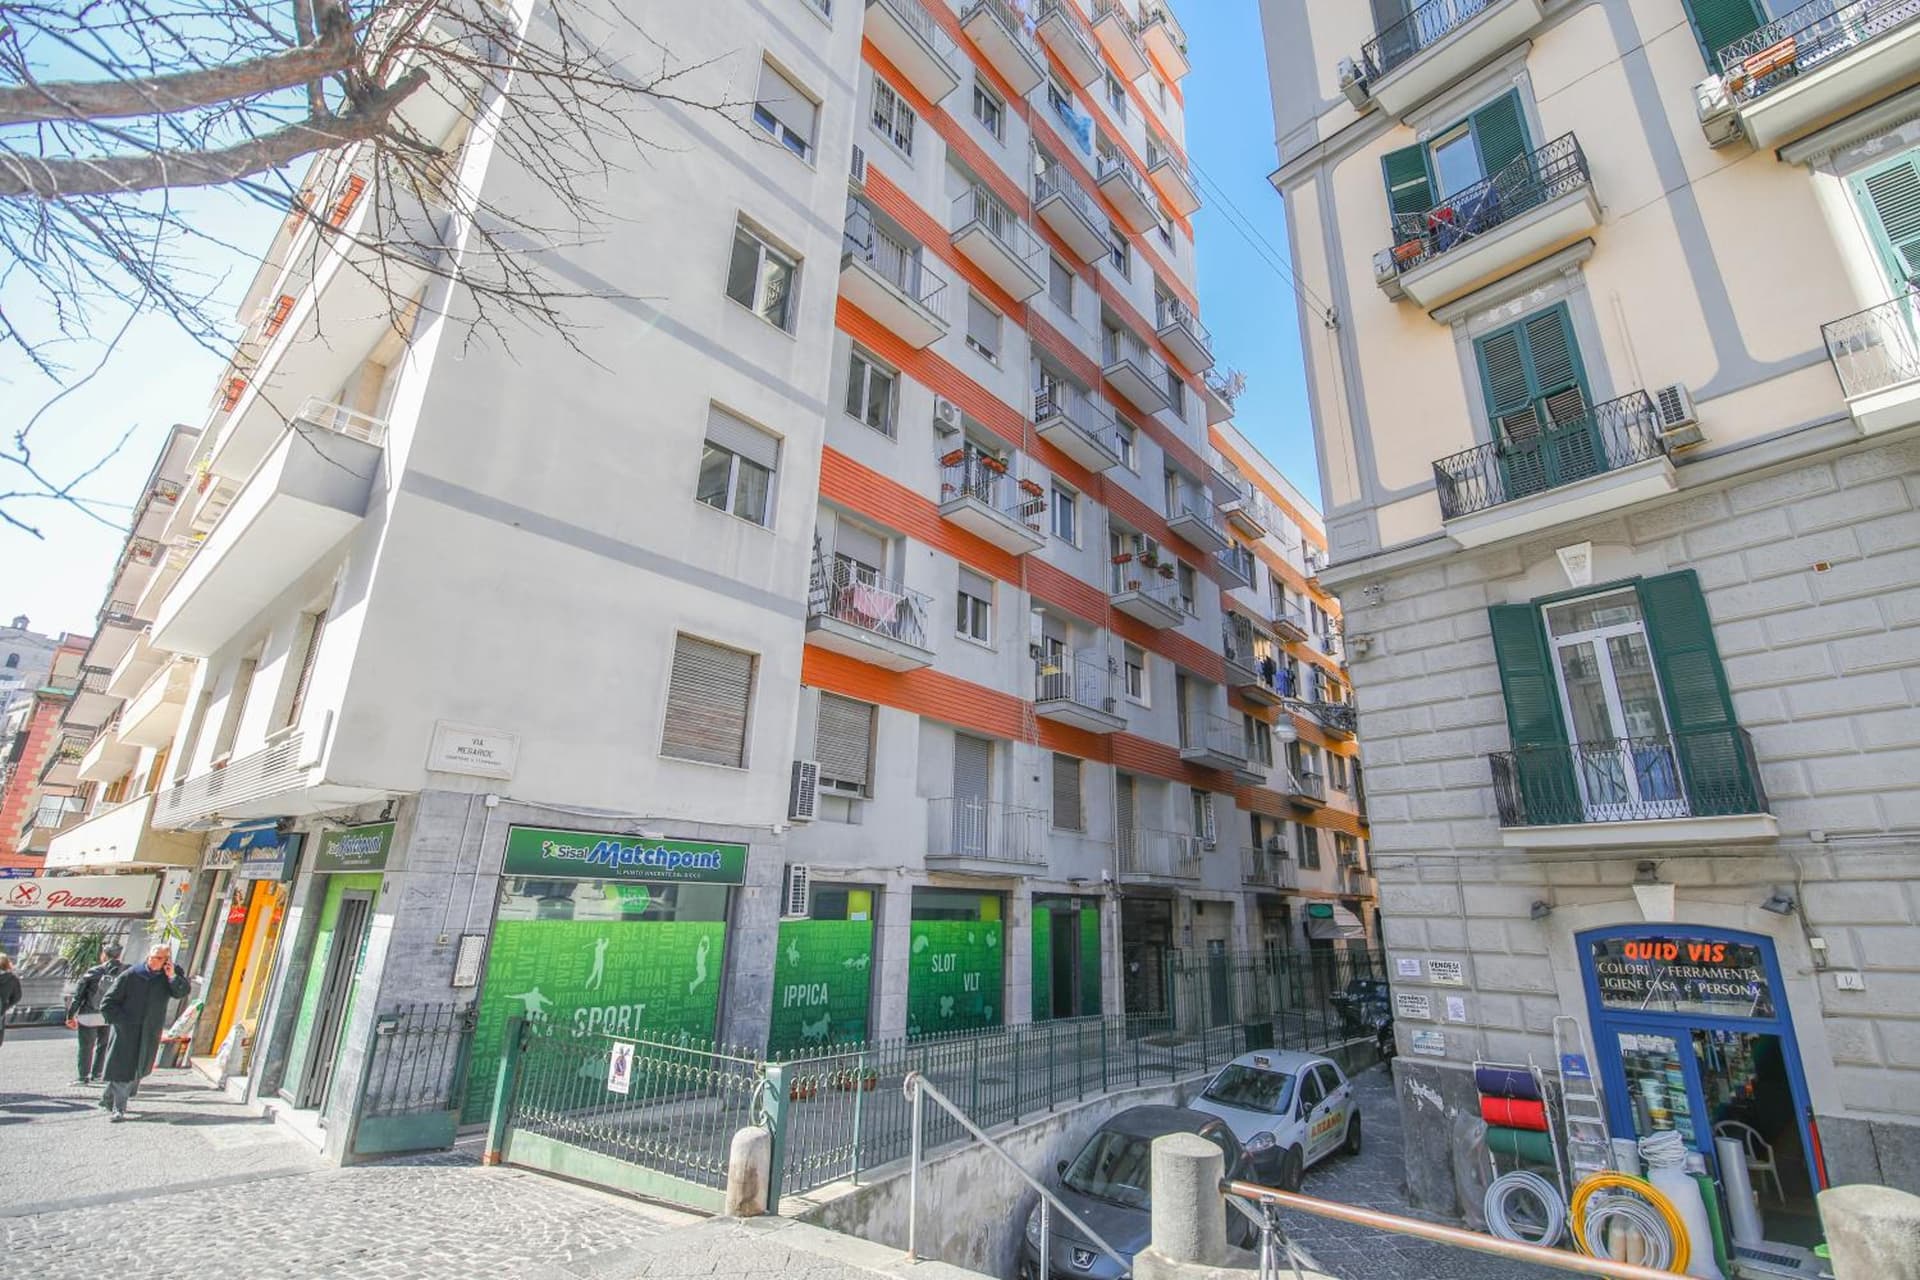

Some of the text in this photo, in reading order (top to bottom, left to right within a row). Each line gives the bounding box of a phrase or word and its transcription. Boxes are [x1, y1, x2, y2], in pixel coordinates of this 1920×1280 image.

[558, 840, 721, 869] Sisal Matchpoint
[47, 890, 126, 910] Pizzeria
[1624, 942, 1727, 962] QUID VIS
[931, 953, 957, 973] SLOT
[1599, 961, 1760, 982] COLORI FERRAMENTA
[963, 972, 981, 992] VLT
[1605, 977, 1647, 990] IGIENE
[1700, 982, 1761, 996] PERSONA
[783, 982, 829, 1008] IPPICA
[571, 1003, 646, 1038] SPORT
